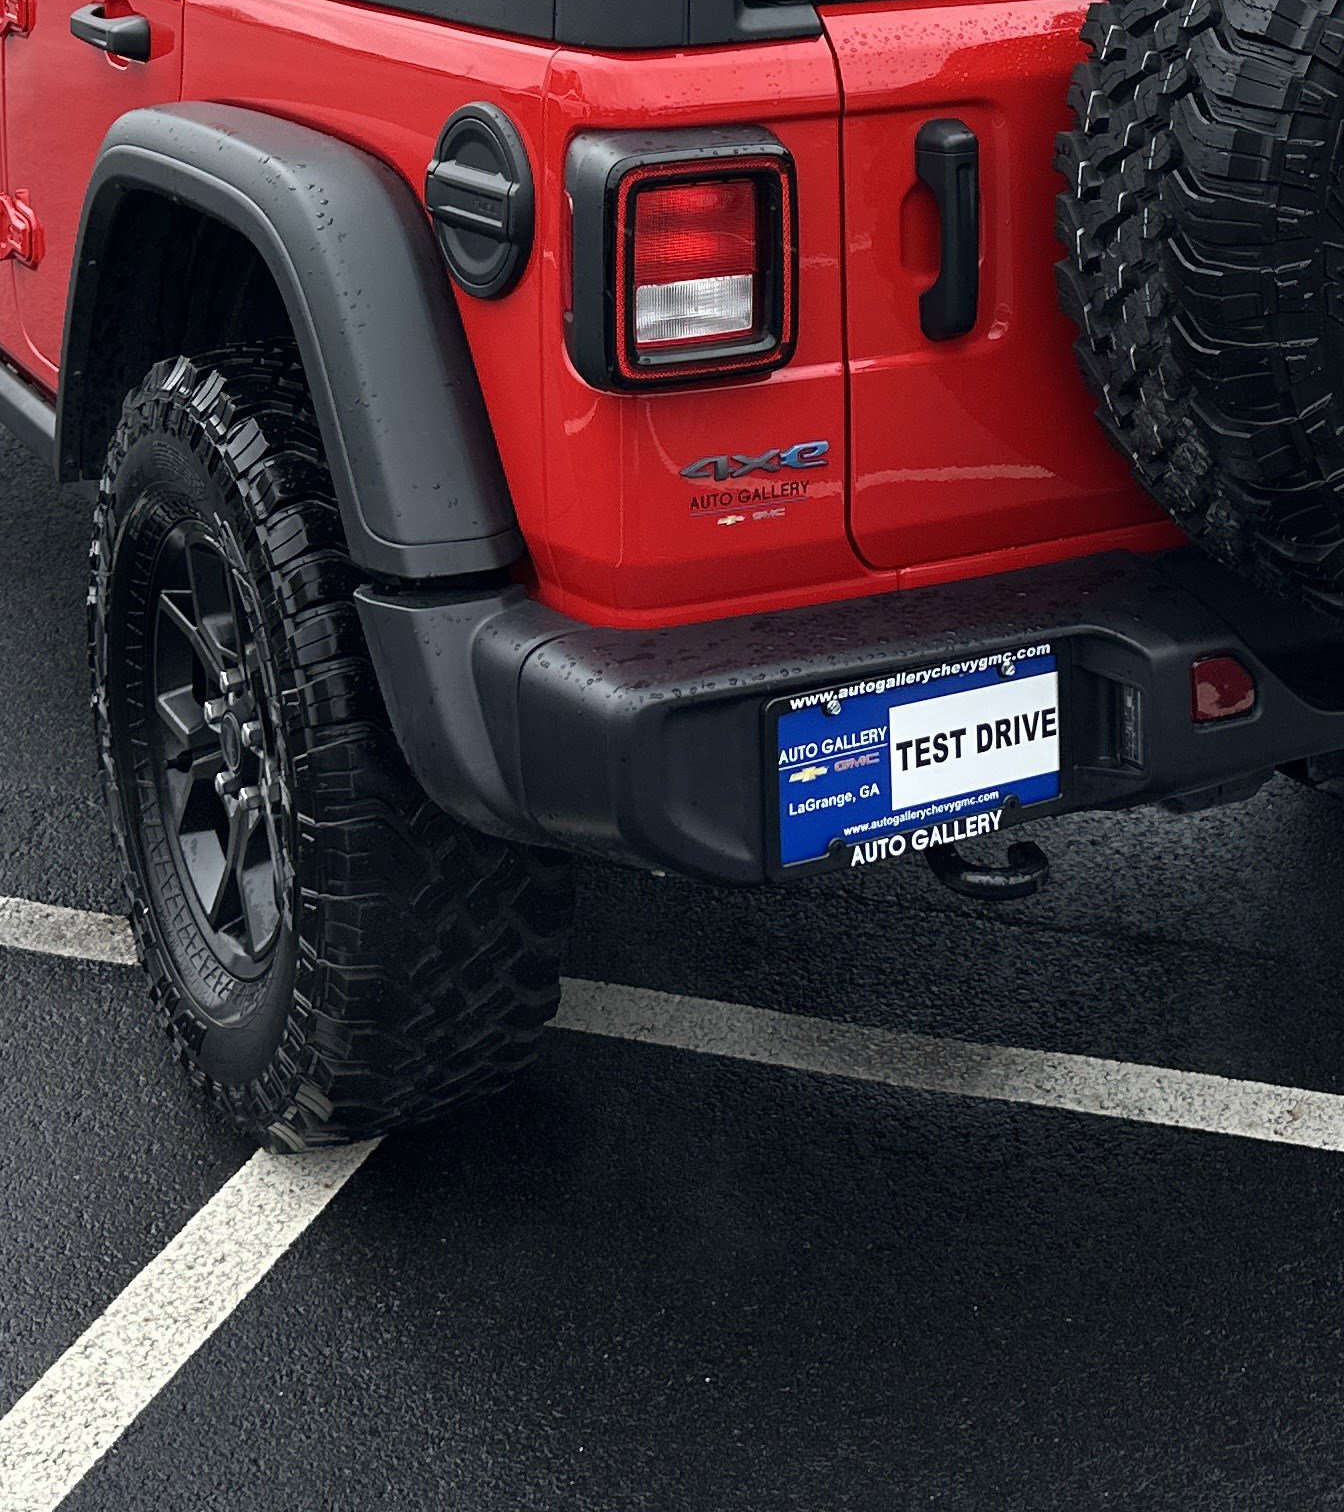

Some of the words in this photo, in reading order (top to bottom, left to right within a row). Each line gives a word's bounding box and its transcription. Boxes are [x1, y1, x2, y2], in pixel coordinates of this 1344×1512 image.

[689, 491, 734, 511] AUTO
[737, 480, 810, 504] GALLERY
[789, 643, 1051, 711] www.autogallerychevygmc.com
[778, 742, 819, 766] AUTO
[821, 725, 888, 755] GALLERY
[895, 727, 967, 772] TEST
[975, 706, 1057, 755] DRIVE
[833, 751, 880, 772] GMC
[788, 791, 857, 817] LaGrange,
[859, 782, 881, 799] GA
[843, 789, 1000, 837] www.autogallerychevygmc.com
[850, 834, 907, 868] AUTO
[910, 808, 1003, 851] GALLERY
